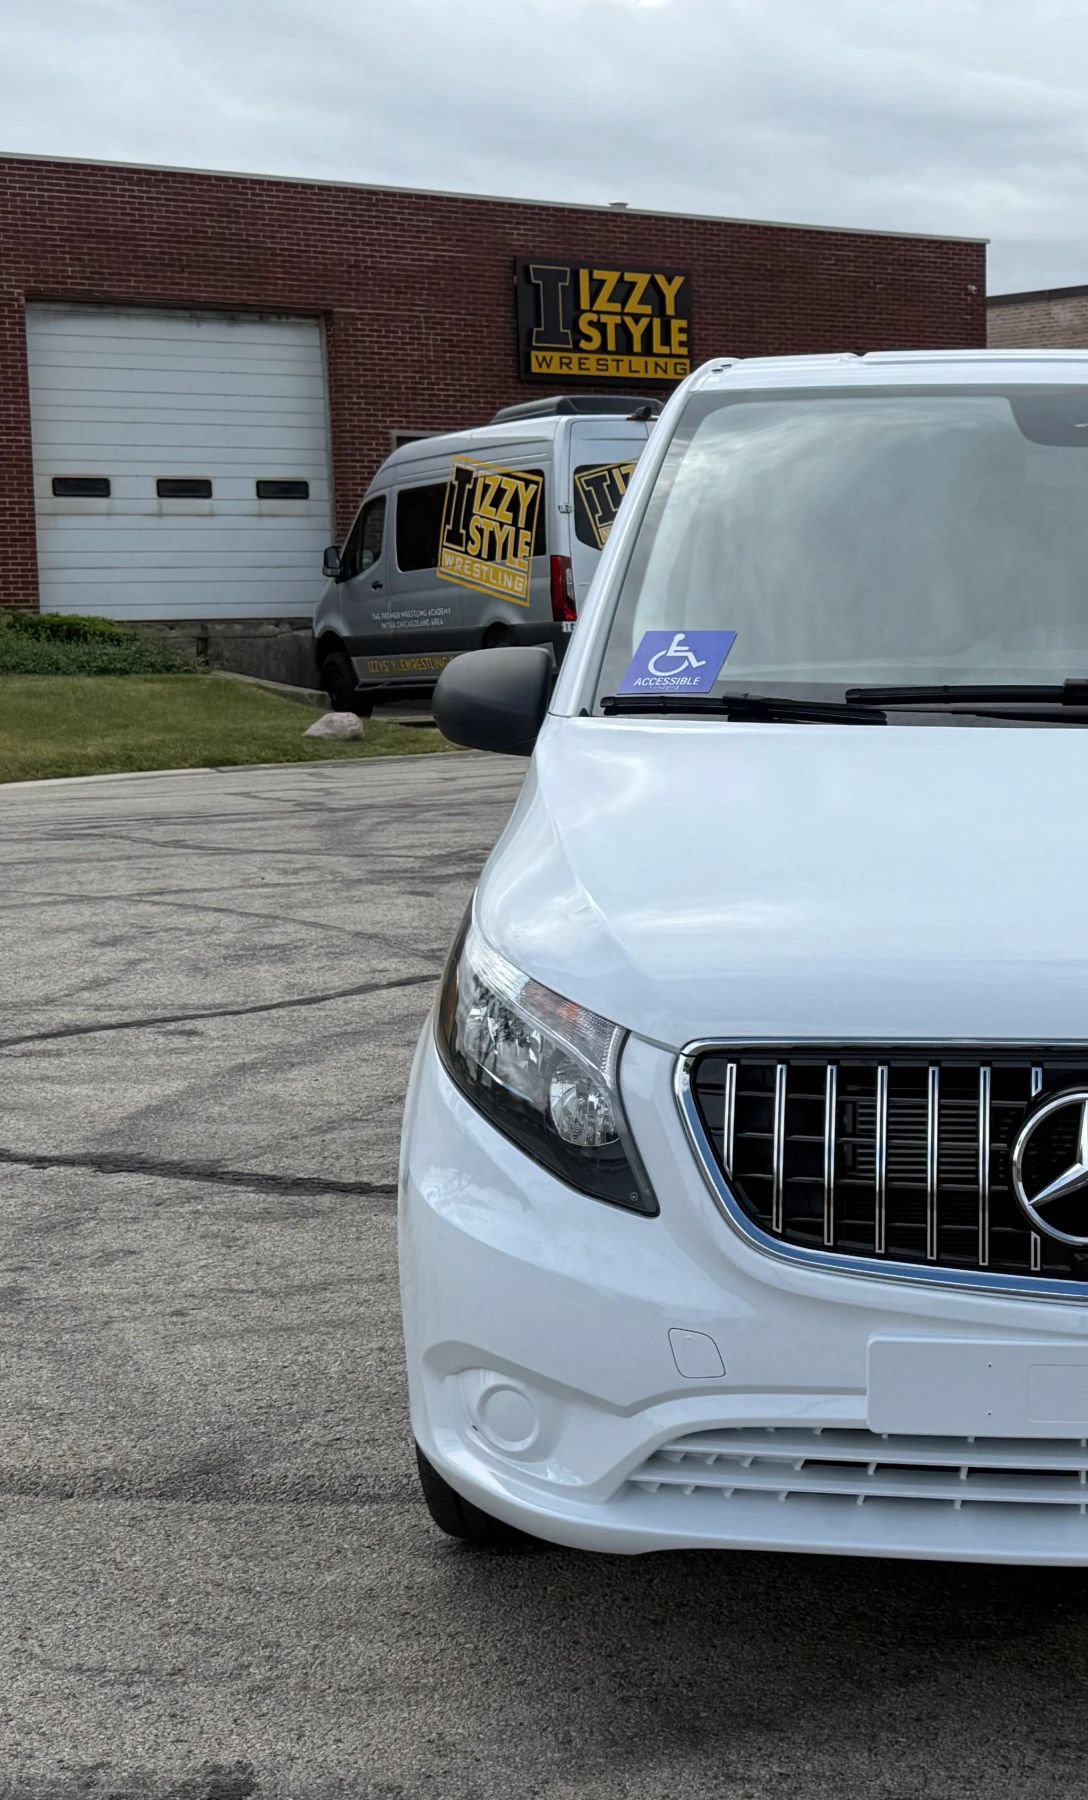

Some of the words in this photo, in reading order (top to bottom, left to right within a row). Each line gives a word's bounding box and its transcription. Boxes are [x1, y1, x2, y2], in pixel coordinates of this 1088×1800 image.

[529, 264, 573, 348] I
[579, 268, 685, 315] IZZY
[578, 312, 688, 355] STYLE
[535, 355, 688, 376] WRESTLING
[473, 471, 538, 528] IZZY
[467, 514, 531, 572] STYLE
[442, 554, 525, 592] WRESTLING
[634, 677, 701, 686] ACCESSIBLE
